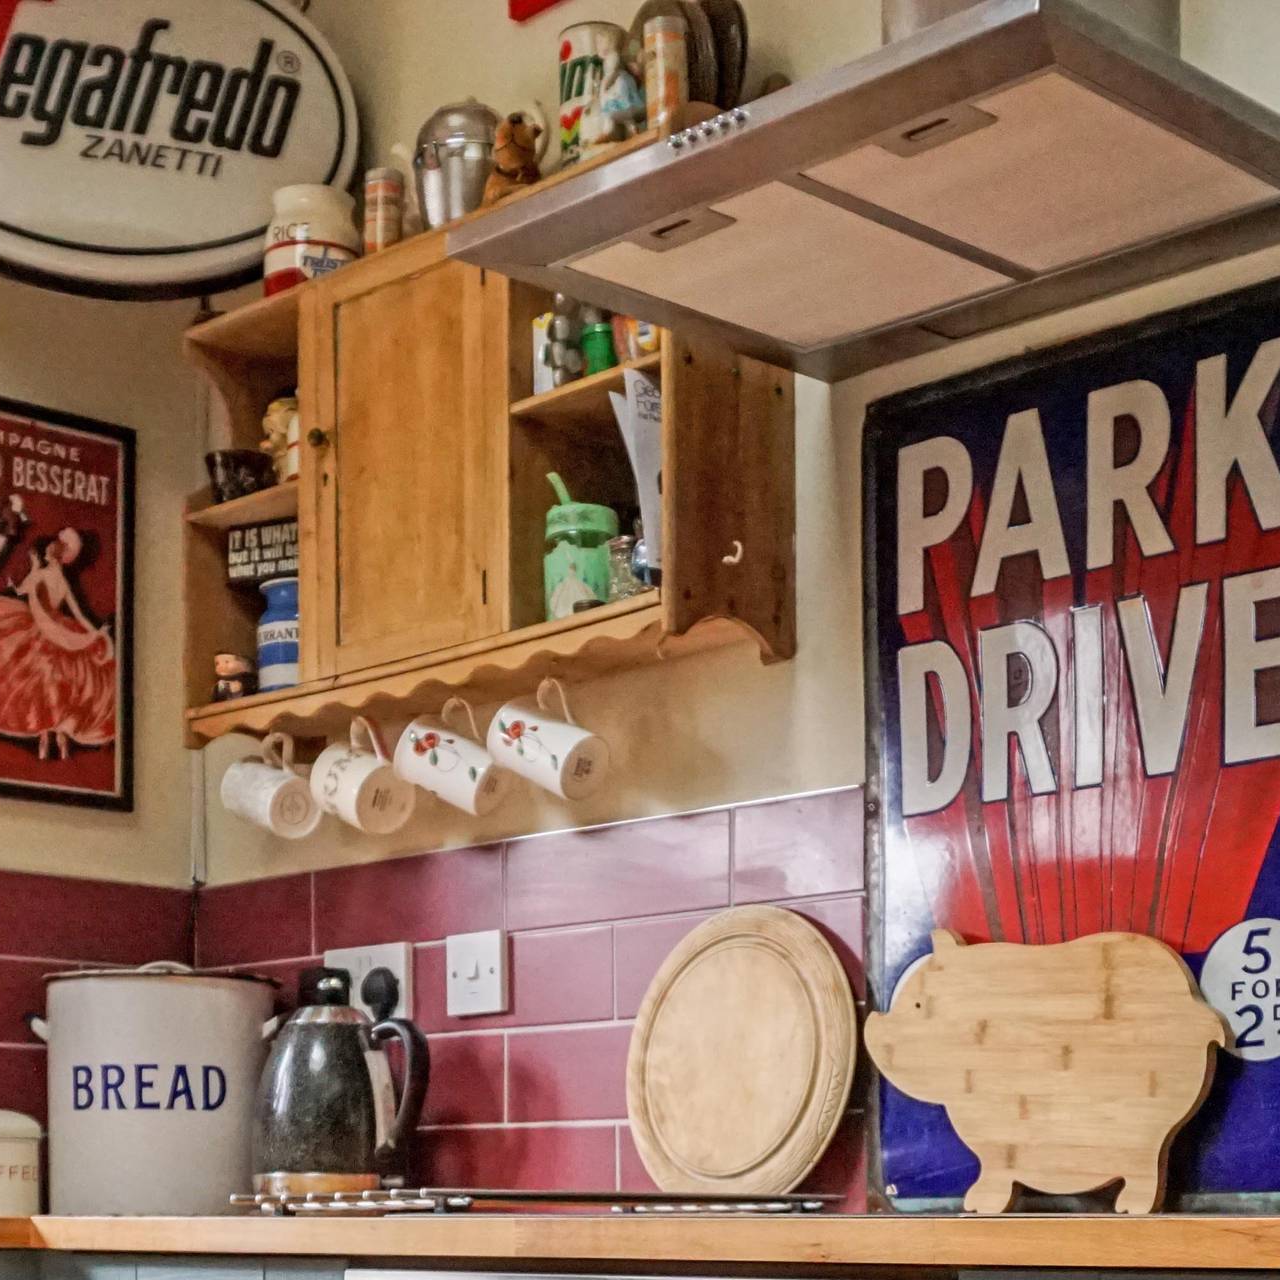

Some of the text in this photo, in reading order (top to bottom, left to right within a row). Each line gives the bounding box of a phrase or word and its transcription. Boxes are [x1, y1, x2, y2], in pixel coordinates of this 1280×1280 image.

[80, 134, 223, 178] ZANETTI
[12, 456, 111, 506] BESSERAT
[228, 530, 241, 551] IT
[245, 527, 258, 548] IS
[1241, 927, 1272, 975] 5
[1234, 1004, 1265, 1049] 2
[72, 1063, 228, 1112] BREAD
